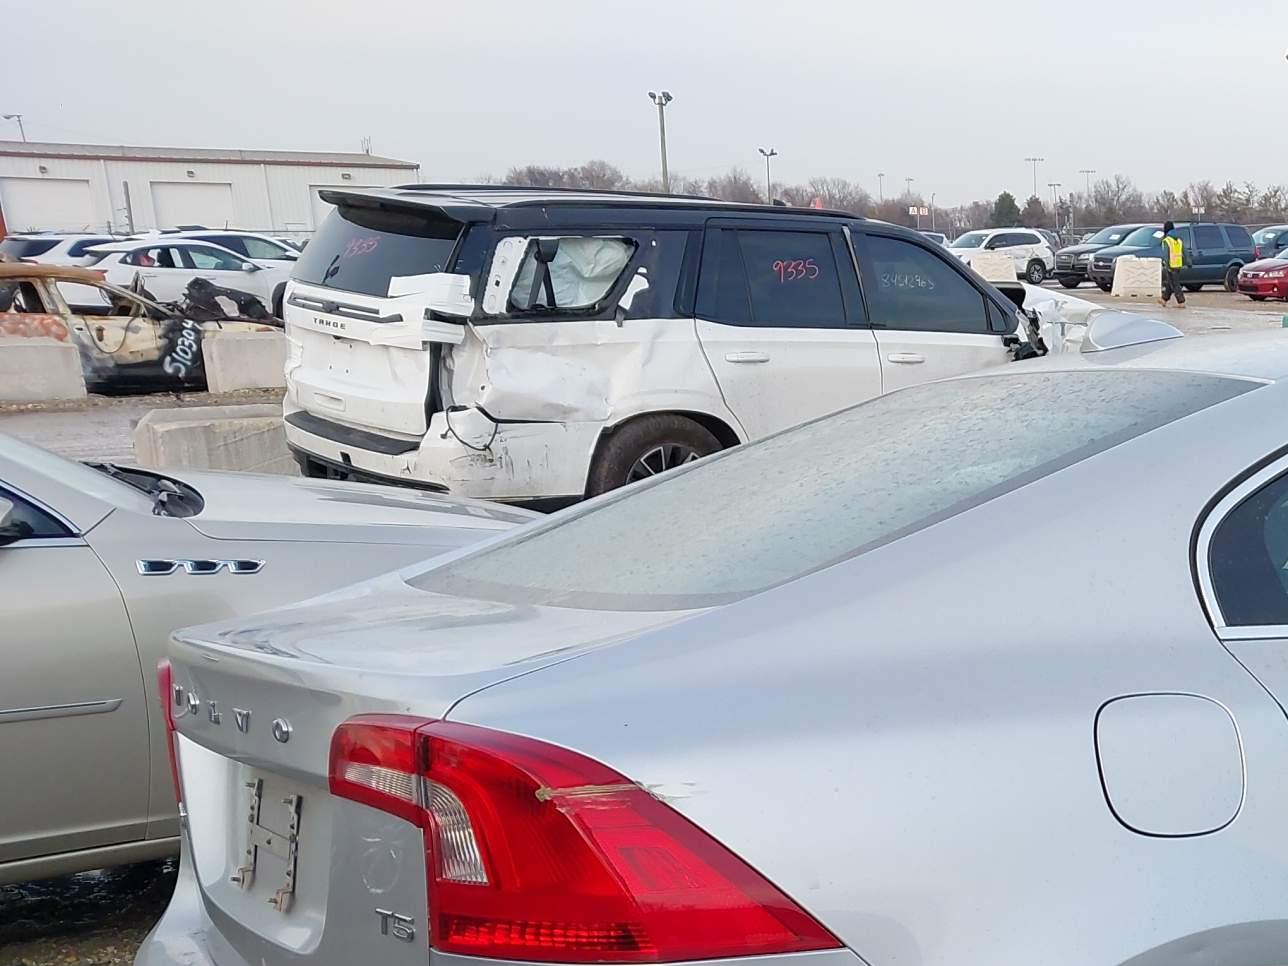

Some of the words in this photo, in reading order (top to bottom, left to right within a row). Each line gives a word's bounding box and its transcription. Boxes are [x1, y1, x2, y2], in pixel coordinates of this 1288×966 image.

[772, 258, 819, 283] 9335
[313, 317, 346, 330] TAHOE
[376, 908, 416, 943] T5
